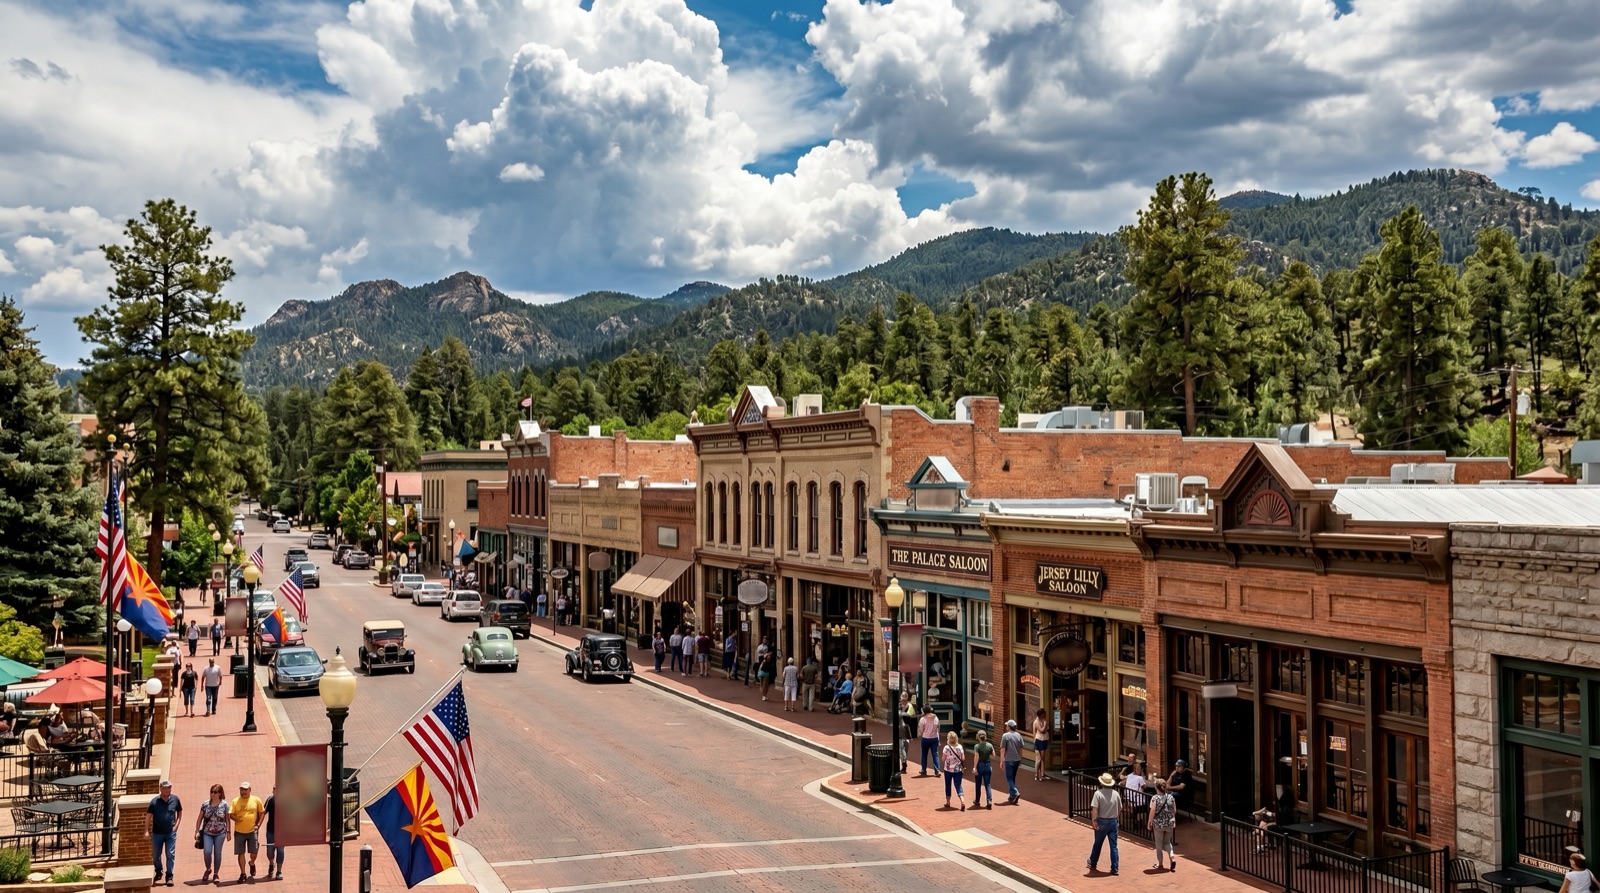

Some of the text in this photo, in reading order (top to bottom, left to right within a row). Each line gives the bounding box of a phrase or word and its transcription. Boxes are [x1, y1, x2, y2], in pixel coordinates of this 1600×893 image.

[892, 549, 988, 572] THE PALACE SALOON
[1038, 565, 1099, 589] JERSEY LILLY
[1048, 580, 1087, 594] SALOON
